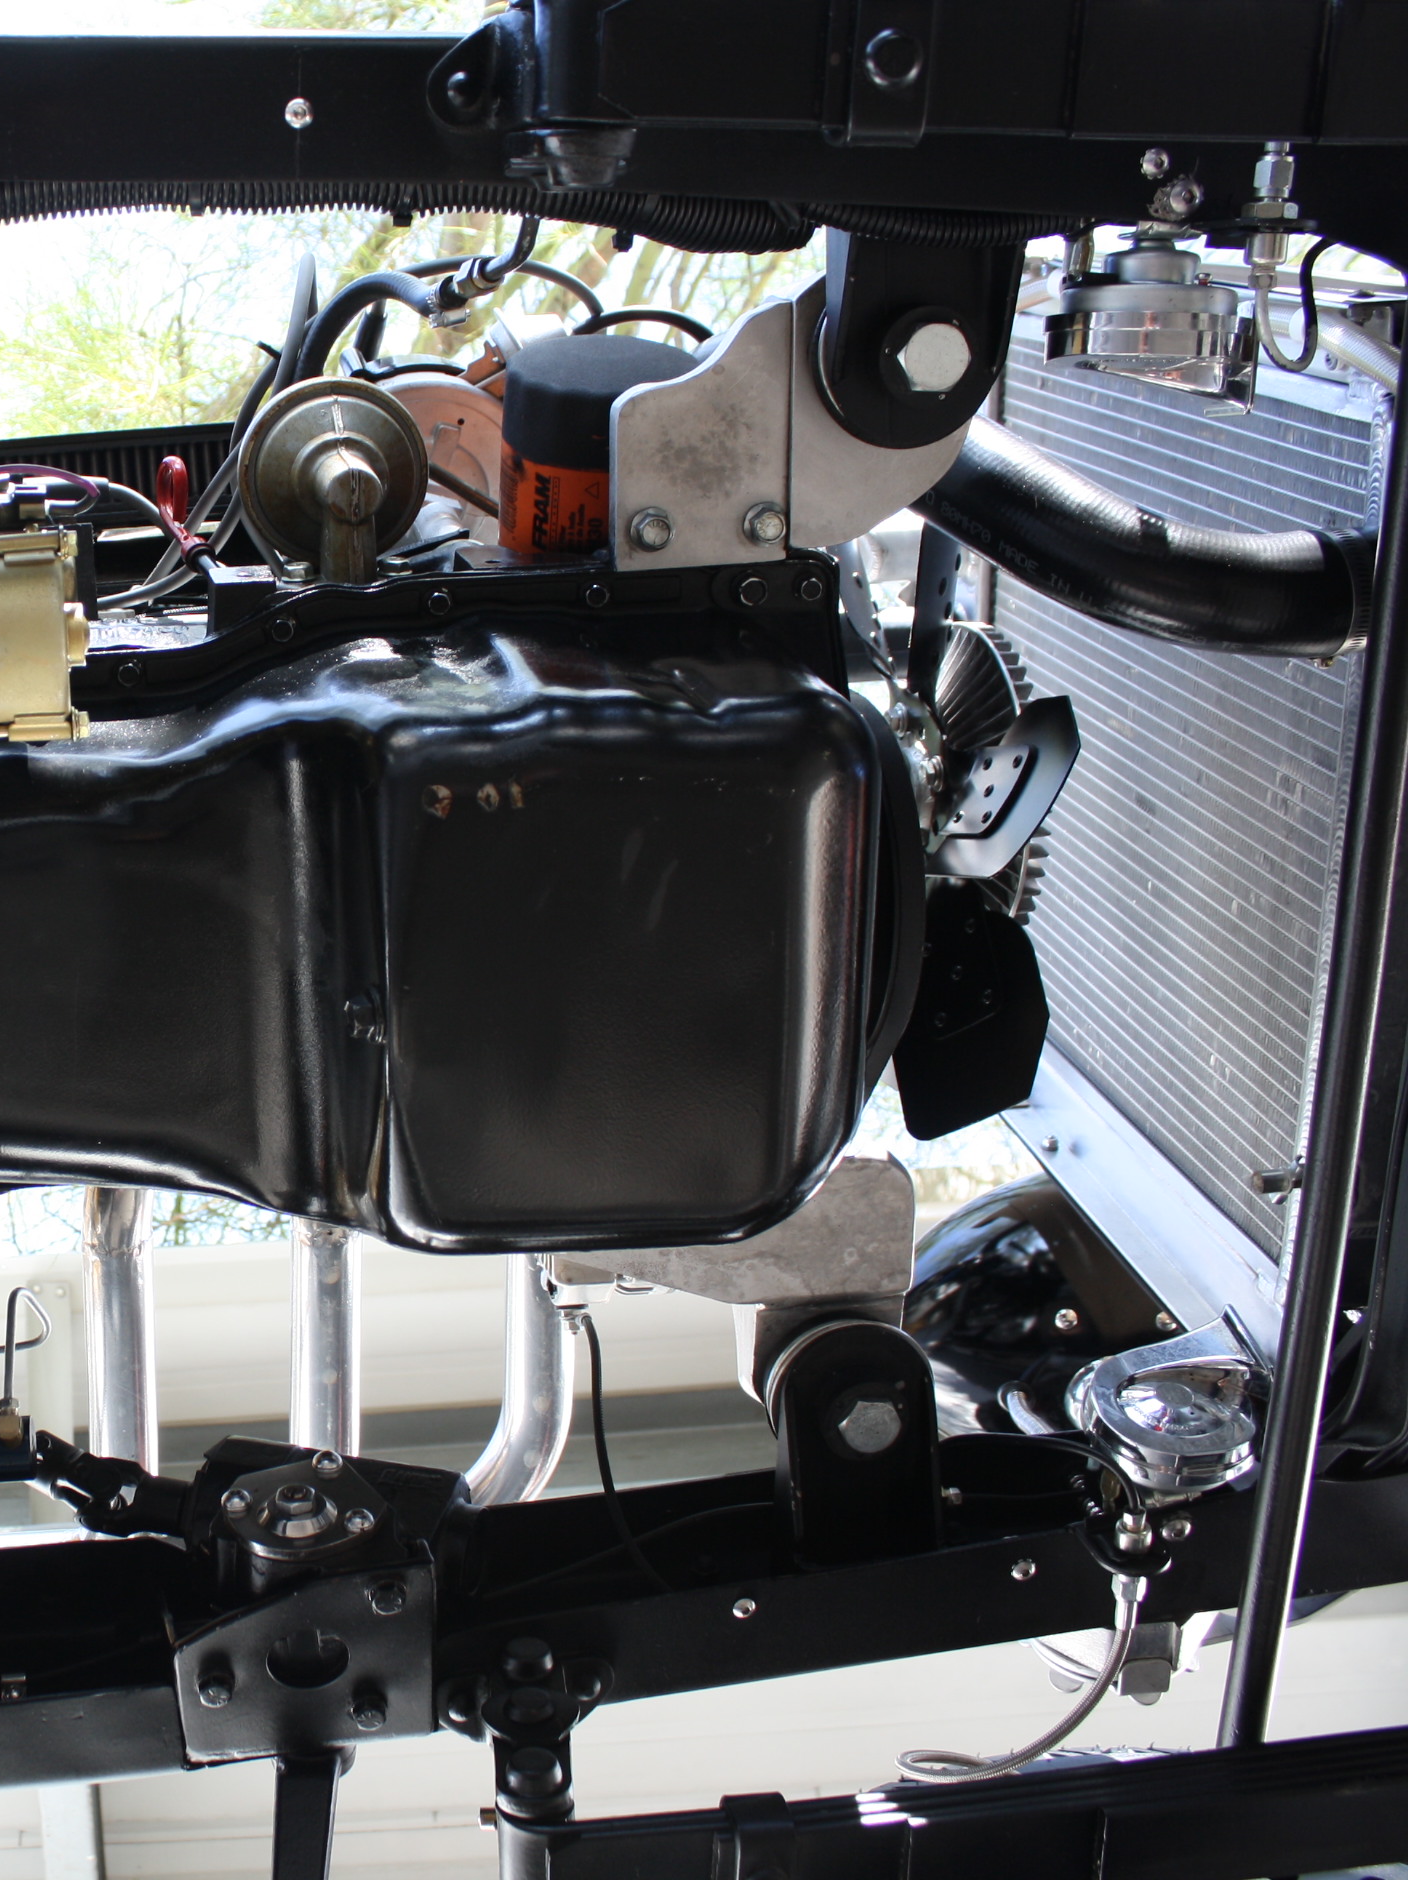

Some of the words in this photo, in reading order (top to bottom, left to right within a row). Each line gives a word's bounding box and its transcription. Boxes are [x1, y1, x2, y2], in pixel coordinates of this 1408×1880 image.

[531, 471, 551, 551] FRAM
[998, 539, 1040, 576] MADE
[1050, 571, 1072, 595] IN
